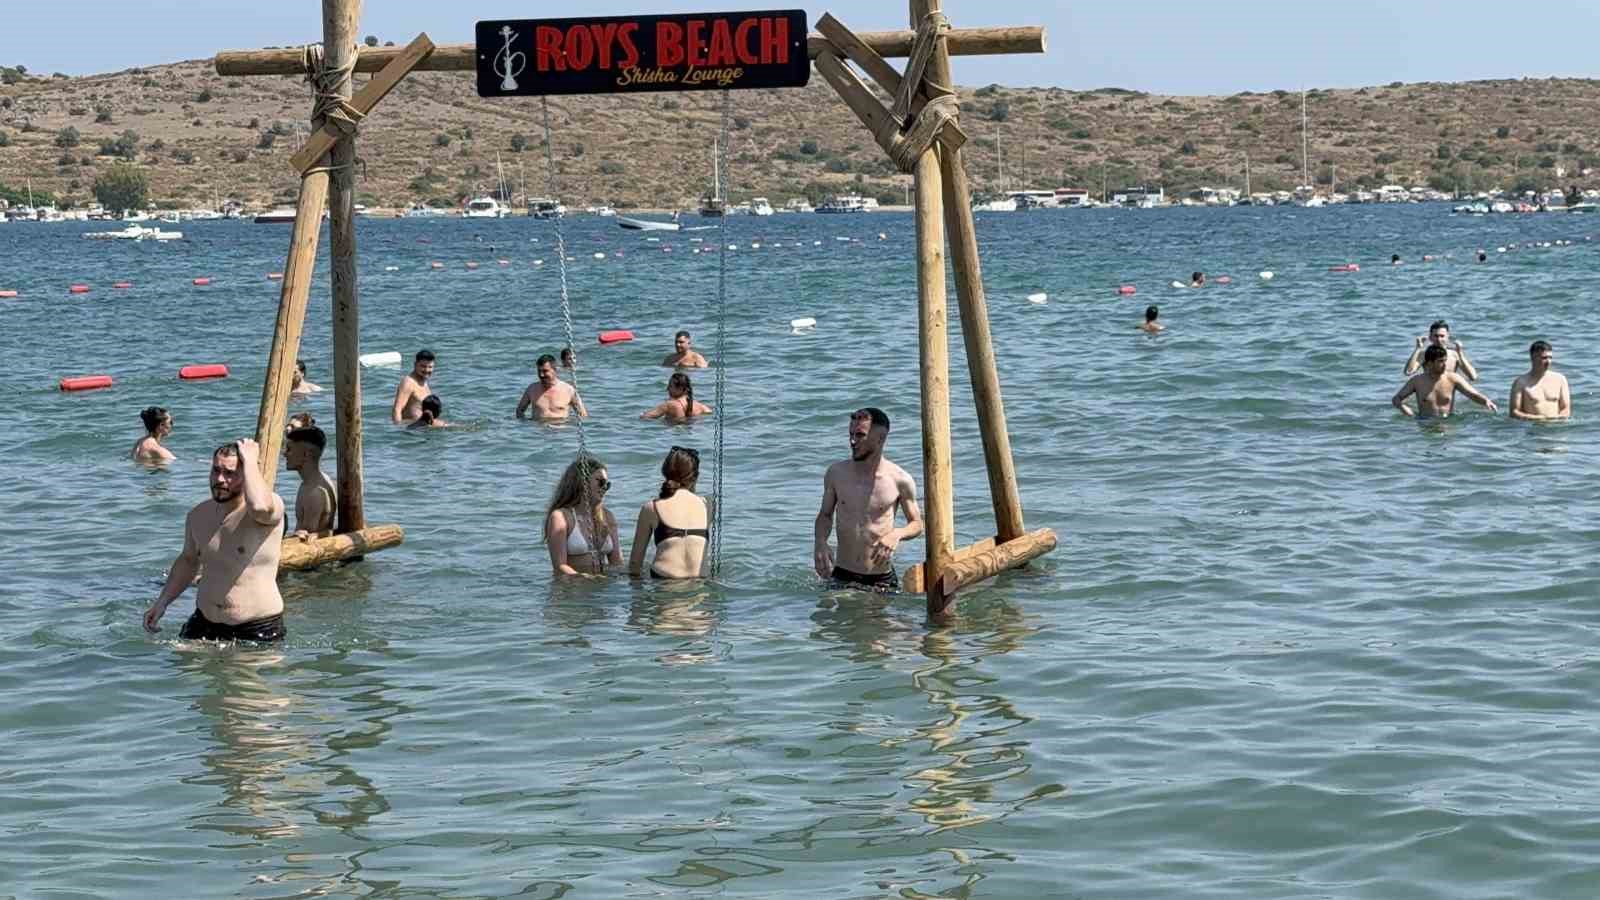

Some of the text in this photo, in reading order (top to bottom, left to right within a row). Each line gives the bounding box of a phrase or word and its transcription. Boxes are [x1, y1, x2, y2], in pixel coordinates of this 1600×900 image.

[535, 17, 788, 71] ROYS BEACH
[616, 65, 743, 86] Shisha Lounge
